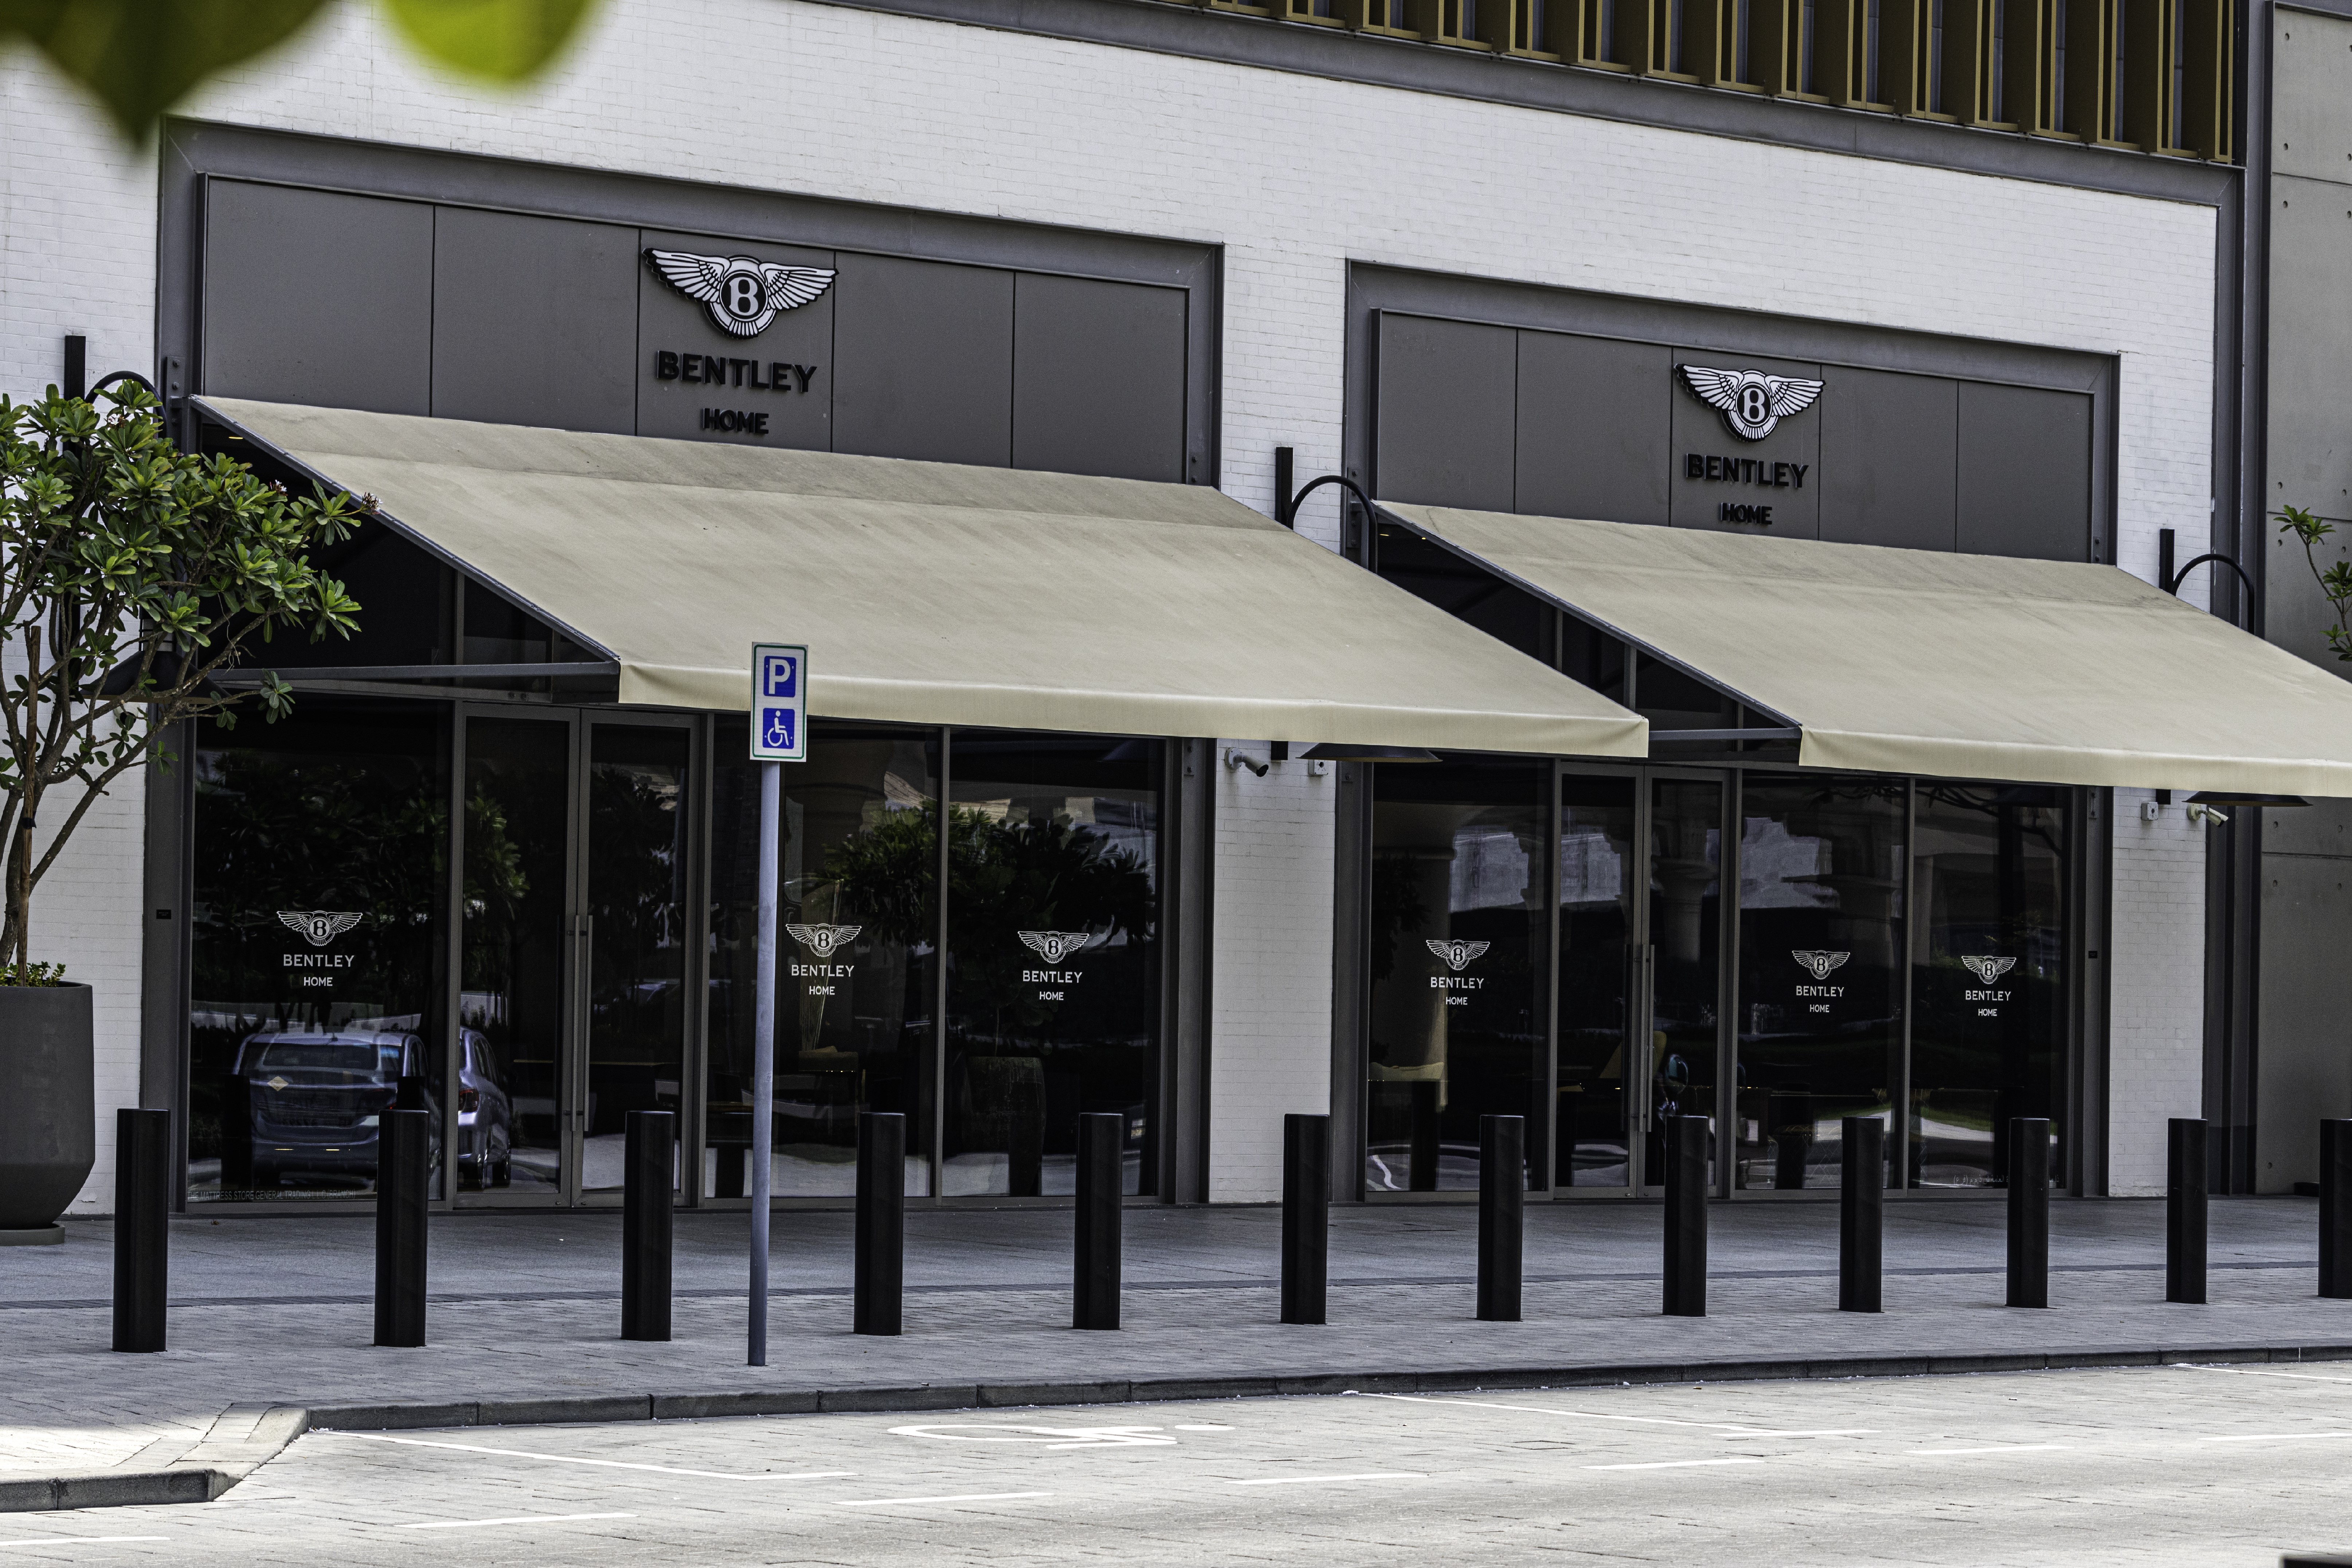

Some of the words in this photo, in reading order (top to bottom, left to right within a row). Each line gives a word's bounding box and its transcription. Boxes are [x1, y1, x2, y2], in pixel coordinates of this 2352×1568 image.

[729, 277, 758, 316] B
[657, 350, 817, 392] BENTLEY
[1743, 388, 1765, 422] B
[703, 407, 769, 434] HOME
[1686, 453, 1809, 488] BENTLEY
[1720, 502, 1772, 525] HOME
[769, 658, 790, 694] P
[313, 920, 326, 937] B
[818, 932, 829, 947] B
[1048, 939, 1058, 955] B
[283, 954, 354, 967] BENTLEY
[1453, 947, 1463, 962] B
[791, 965, 854, 977] BENTLEY
[1816, 958, 1825, 971] B
[1984, 963, 1993, 976] B
[304, 977, 333, 986] HOME
[1023, 970, 1082, 983] BENTLEY
[1431, 977, 1484, 989] BENTLEY
[809, 985, 835, 995] HOME
[1039, 991, 1064, 1001] HOME
[1796, 986, 1844, 997] BENTLEY
[1965, 990, 2011, 1001] BENTLEY
[1445, 997, 1468, 1005] HOME
[1810, 1004, 1829, 1013] HOME
[187, 1191, 199, 1201] THE
[200, 1191, 232, 1200] MATTRESS
[234, 1190, 254, 1200] STORE
[255, 1190, 283, 1200] GENERAL
[285, 1190, 310, 1199] TRADING
[328, 1189, 356, 1199] (BRANCH)
